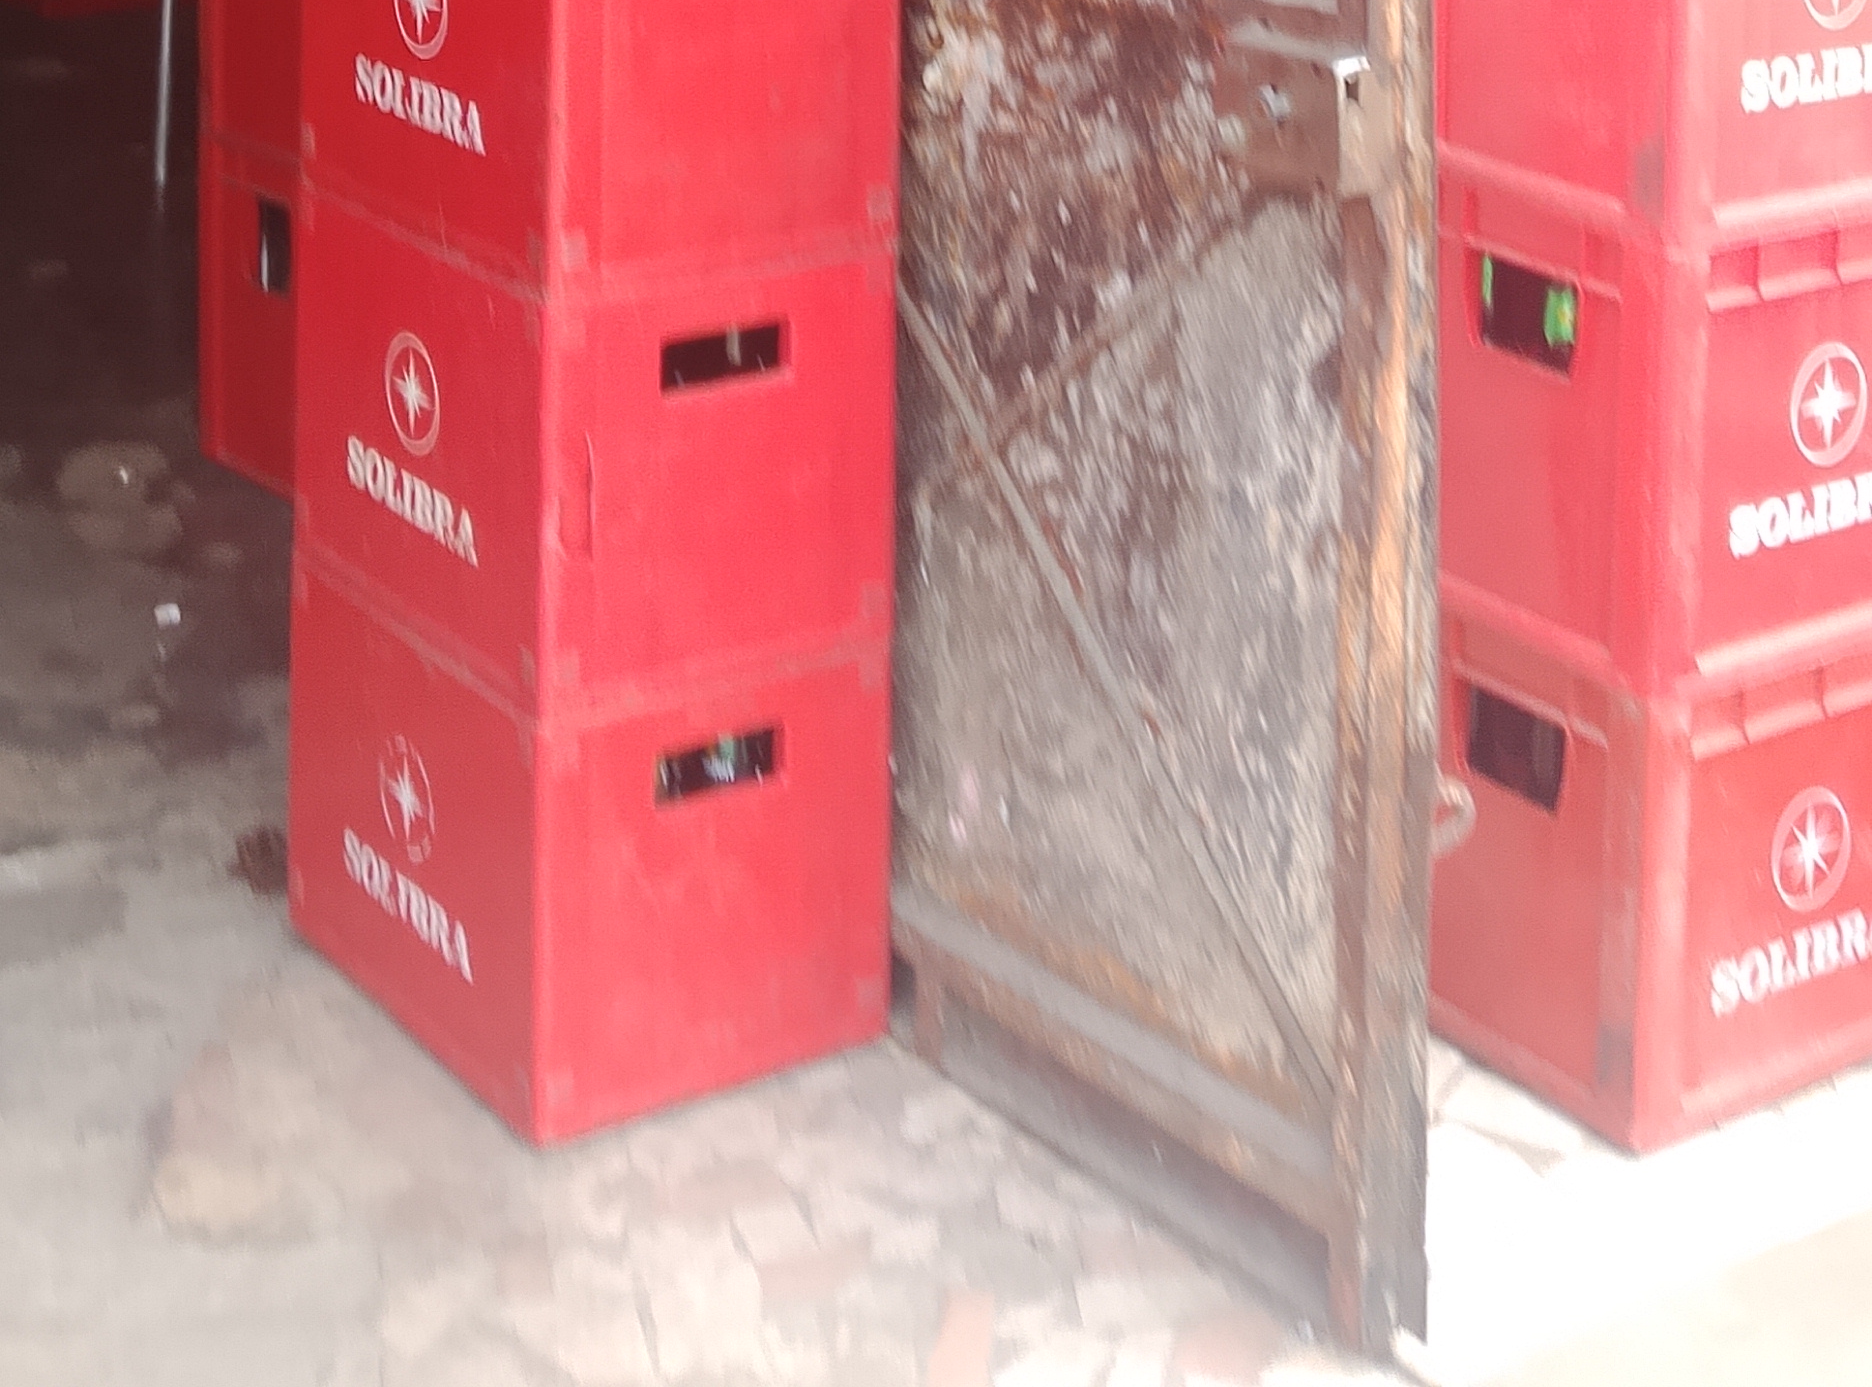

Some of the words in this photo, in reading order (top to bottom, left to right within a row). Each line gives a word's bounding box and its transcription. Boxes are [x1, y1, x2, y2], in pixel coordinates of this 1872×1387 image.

[355, 52, 487, 157] SOLIBRA
[347, 435, 479, 568] SOLIBRA
[343, 827, 474, 986] SOLIBRA
[1709, 907, 1872, 1019] SOLIBR
